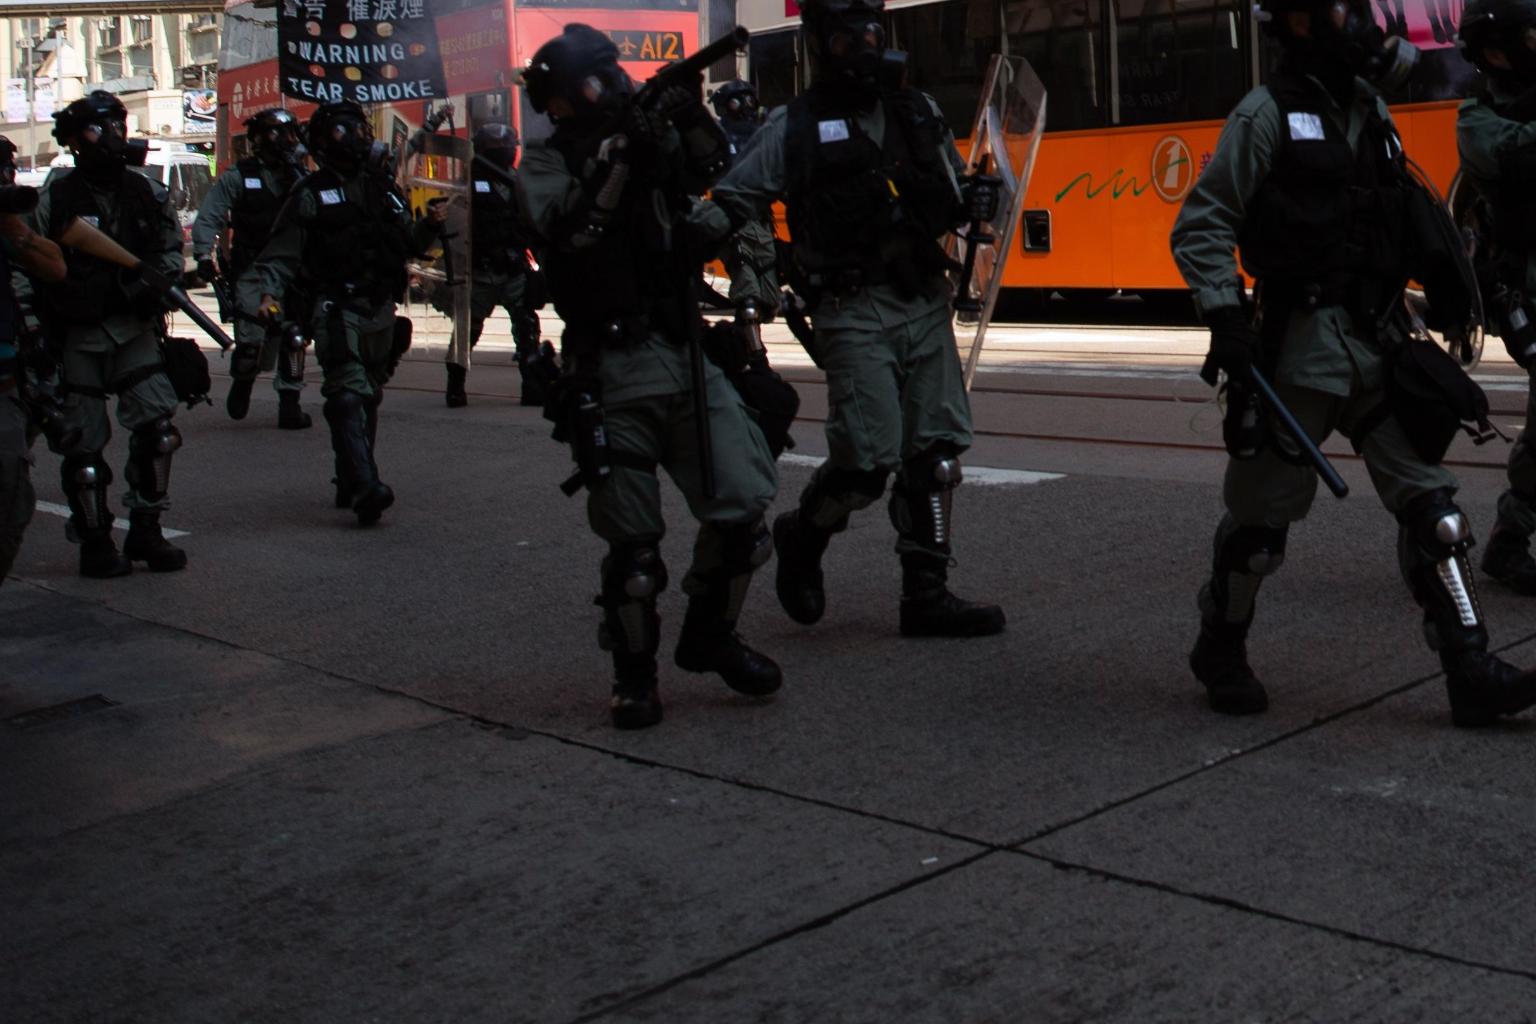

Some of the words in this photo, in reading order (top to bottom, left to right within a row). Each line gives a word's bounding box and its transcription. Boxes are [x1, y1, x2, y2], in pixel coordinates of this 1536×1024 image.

[299, 41, 405, 64] WARNING
[639, 32, 680, 60] A12
[355, 79, 435, 102] SMOKE
